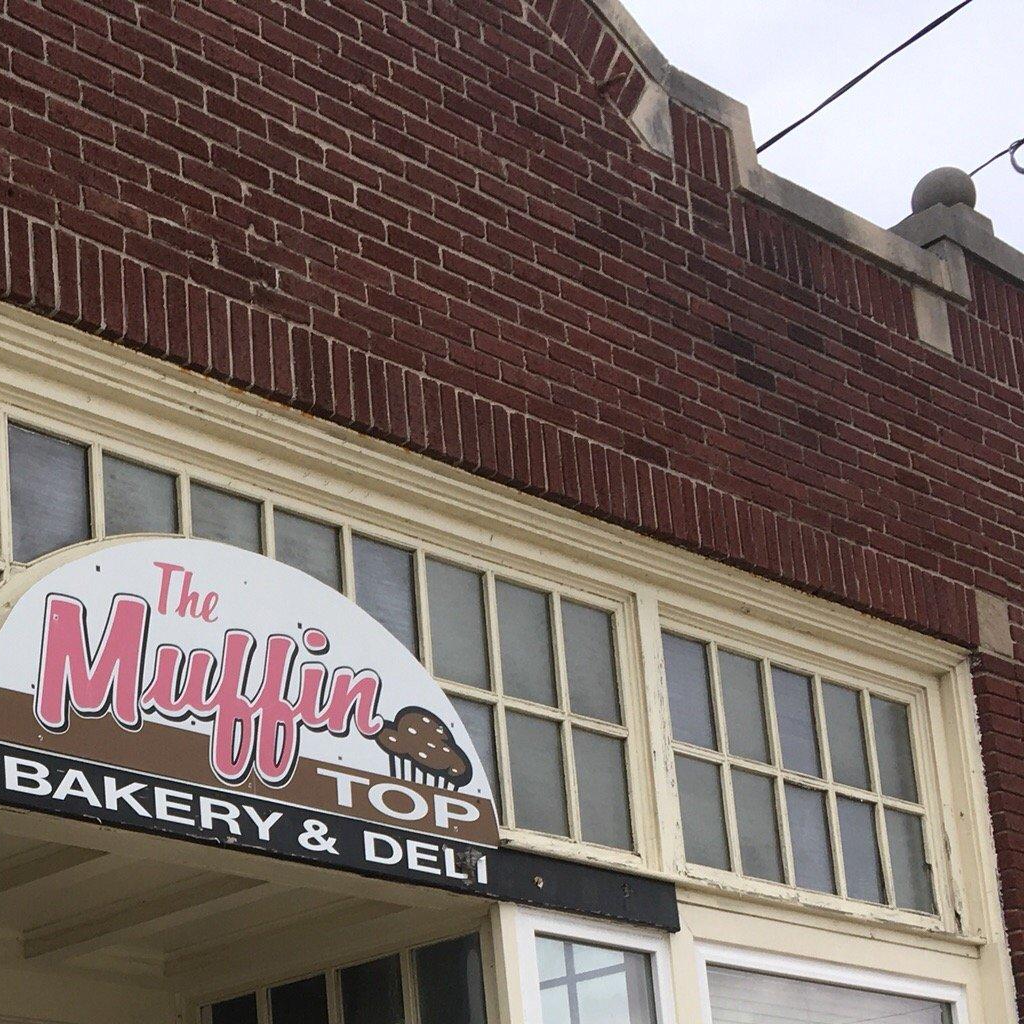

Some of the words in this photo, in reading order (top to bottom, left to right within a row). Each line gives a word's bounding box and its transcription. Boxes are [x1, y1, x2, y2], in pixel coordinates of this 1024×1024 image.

[153, 562, 218, 622] The
[34, 592, 383, 788] Muffin
[4, 756, 282, 841] BAKERY
[298, 821, 338, 855] &
[363, 830, 488, 885] DELI
[317, 768, 480, 829] TOP
